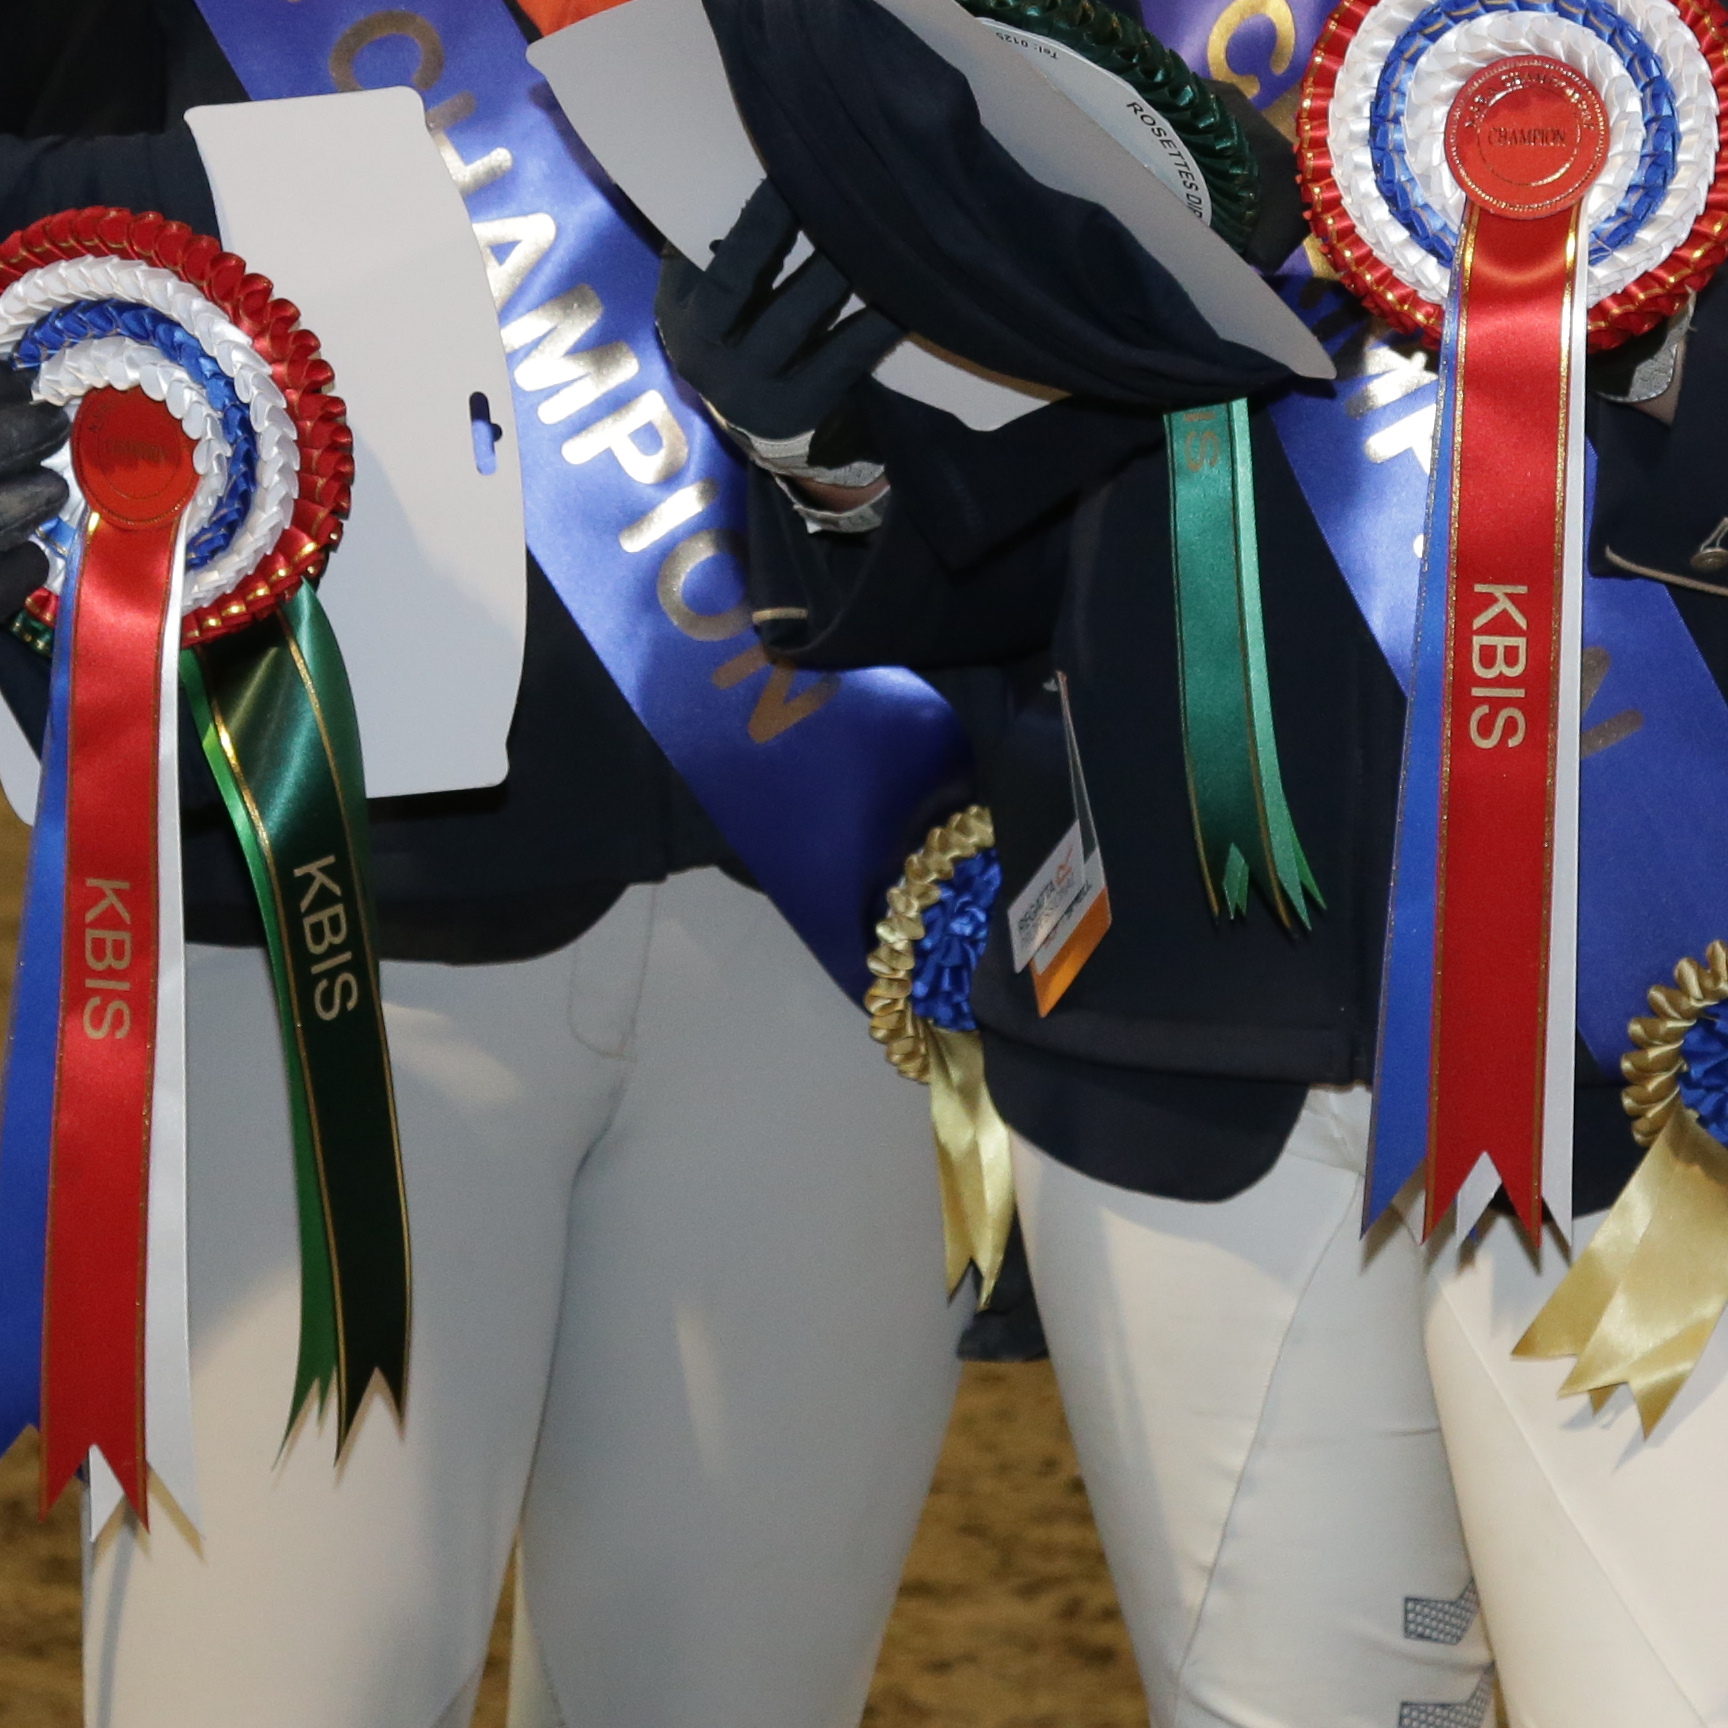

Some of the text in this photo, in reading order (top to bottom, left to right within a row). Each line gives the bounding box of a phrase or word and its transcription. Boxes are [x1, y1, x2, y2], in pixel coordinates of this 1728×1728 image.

[1126, 101, 1200, 192] ROSETTES
[1487, 127, 1568, 147] CHAMPION
[1468, 582, 1529, 751] KBIS
[82, 877, 133, 1042] KBIS
[292, 854, 358, 1022] KBIS
